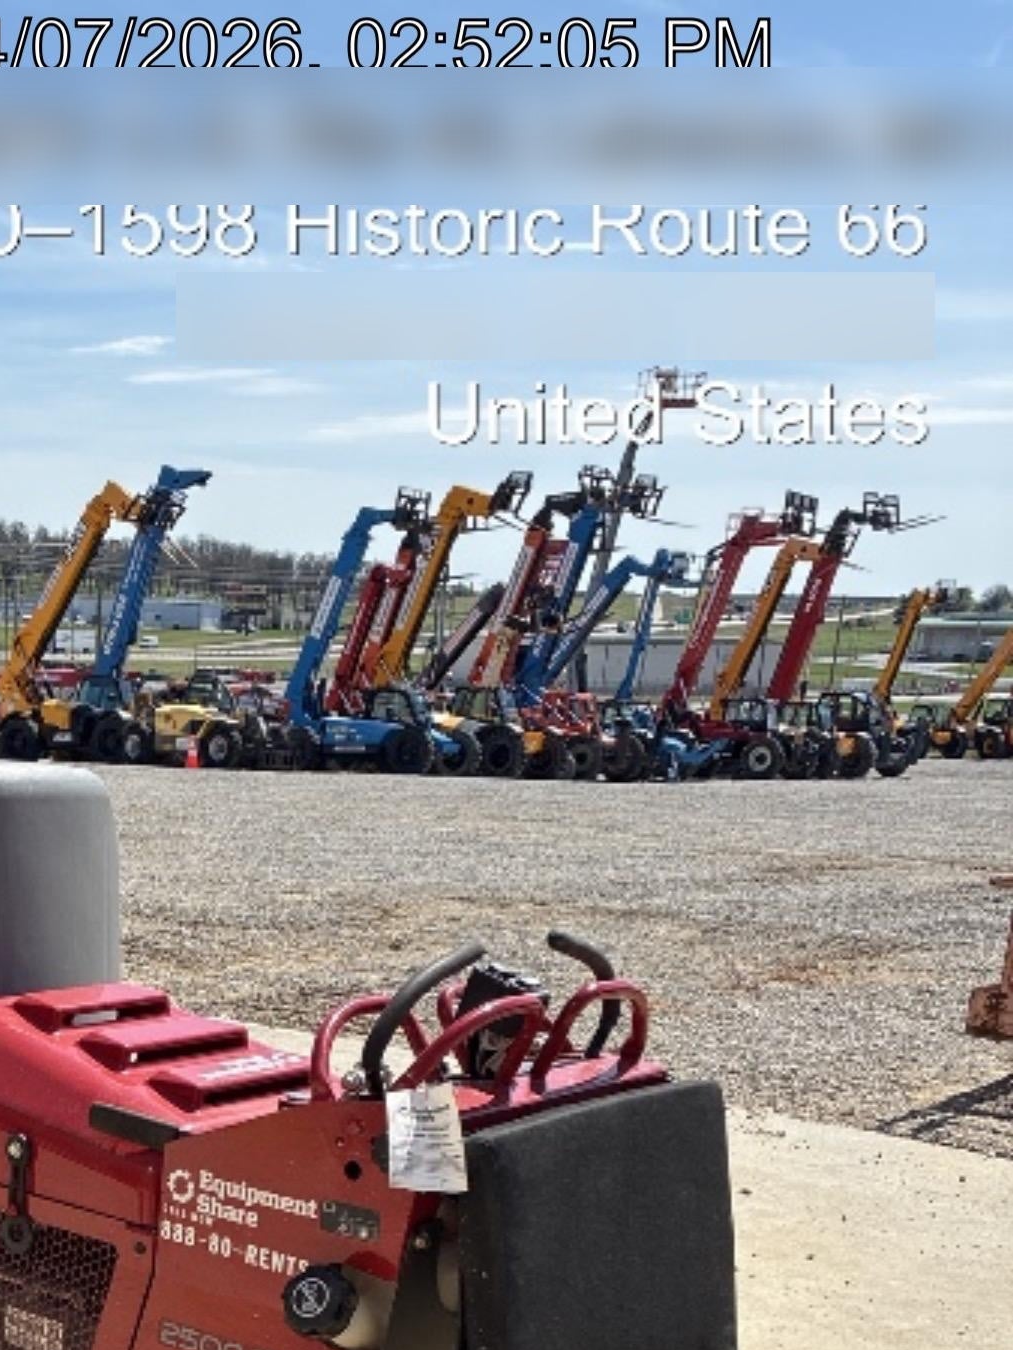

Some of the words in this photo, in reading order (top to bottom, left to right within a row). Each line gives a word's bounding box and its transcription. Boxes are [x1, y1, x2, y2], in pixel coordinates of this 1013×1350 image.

[195, 1193, 259, 1228] Share
[198, 1169, 319, 1220] Equipment
[159, 1219, 310, 1275] 888-80-RENTS
